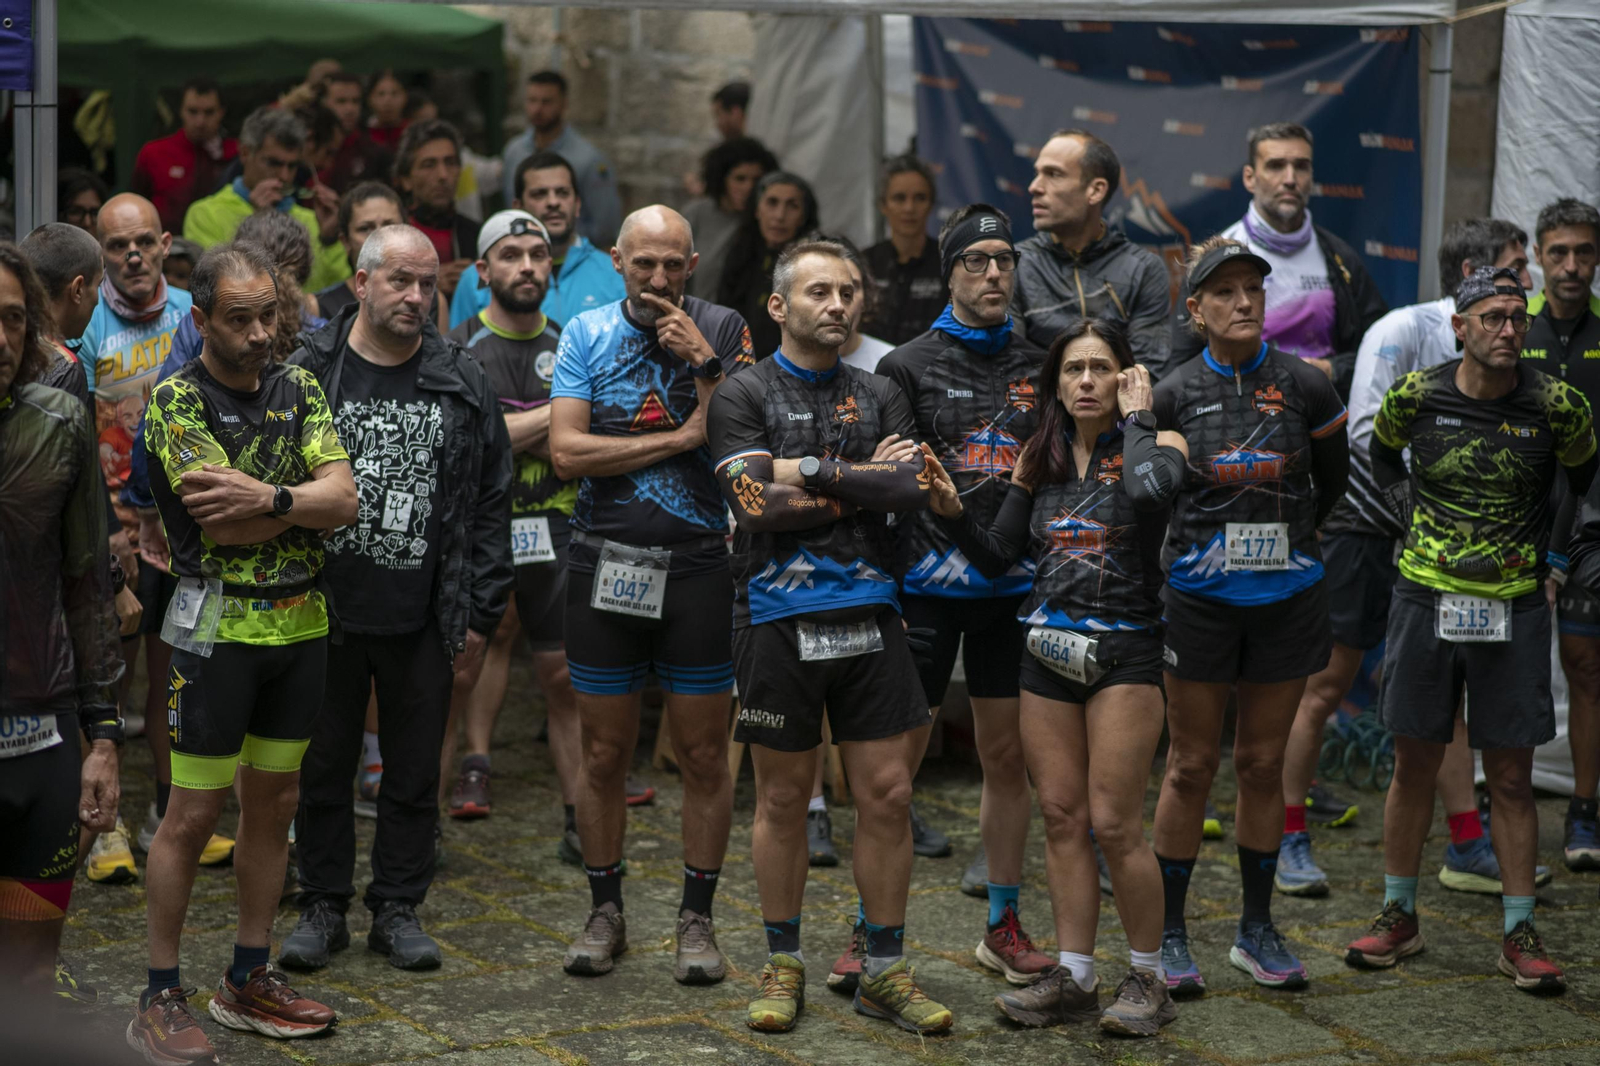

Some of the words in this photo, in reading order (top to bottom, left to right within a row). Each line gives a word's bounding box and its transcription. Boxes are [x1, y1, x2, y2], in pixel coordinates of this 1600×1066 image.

[95, 327, 176, 387] PLATA
[1243, 538, 1276, 557] 177
[1230, 558, 1262, 566] BACKYARD
[613, 570, 653, 582] SPAIN
[613, 579, 650, 602] 047
[600, 596, 632, 608] BACKYARD
[632, 602, 658, 612] ULTRA
[1455, 609, 1489, 628] 115
[1040, 631, 1076, 648] SPAIN
[1041, 640, 1070, 665] 064
